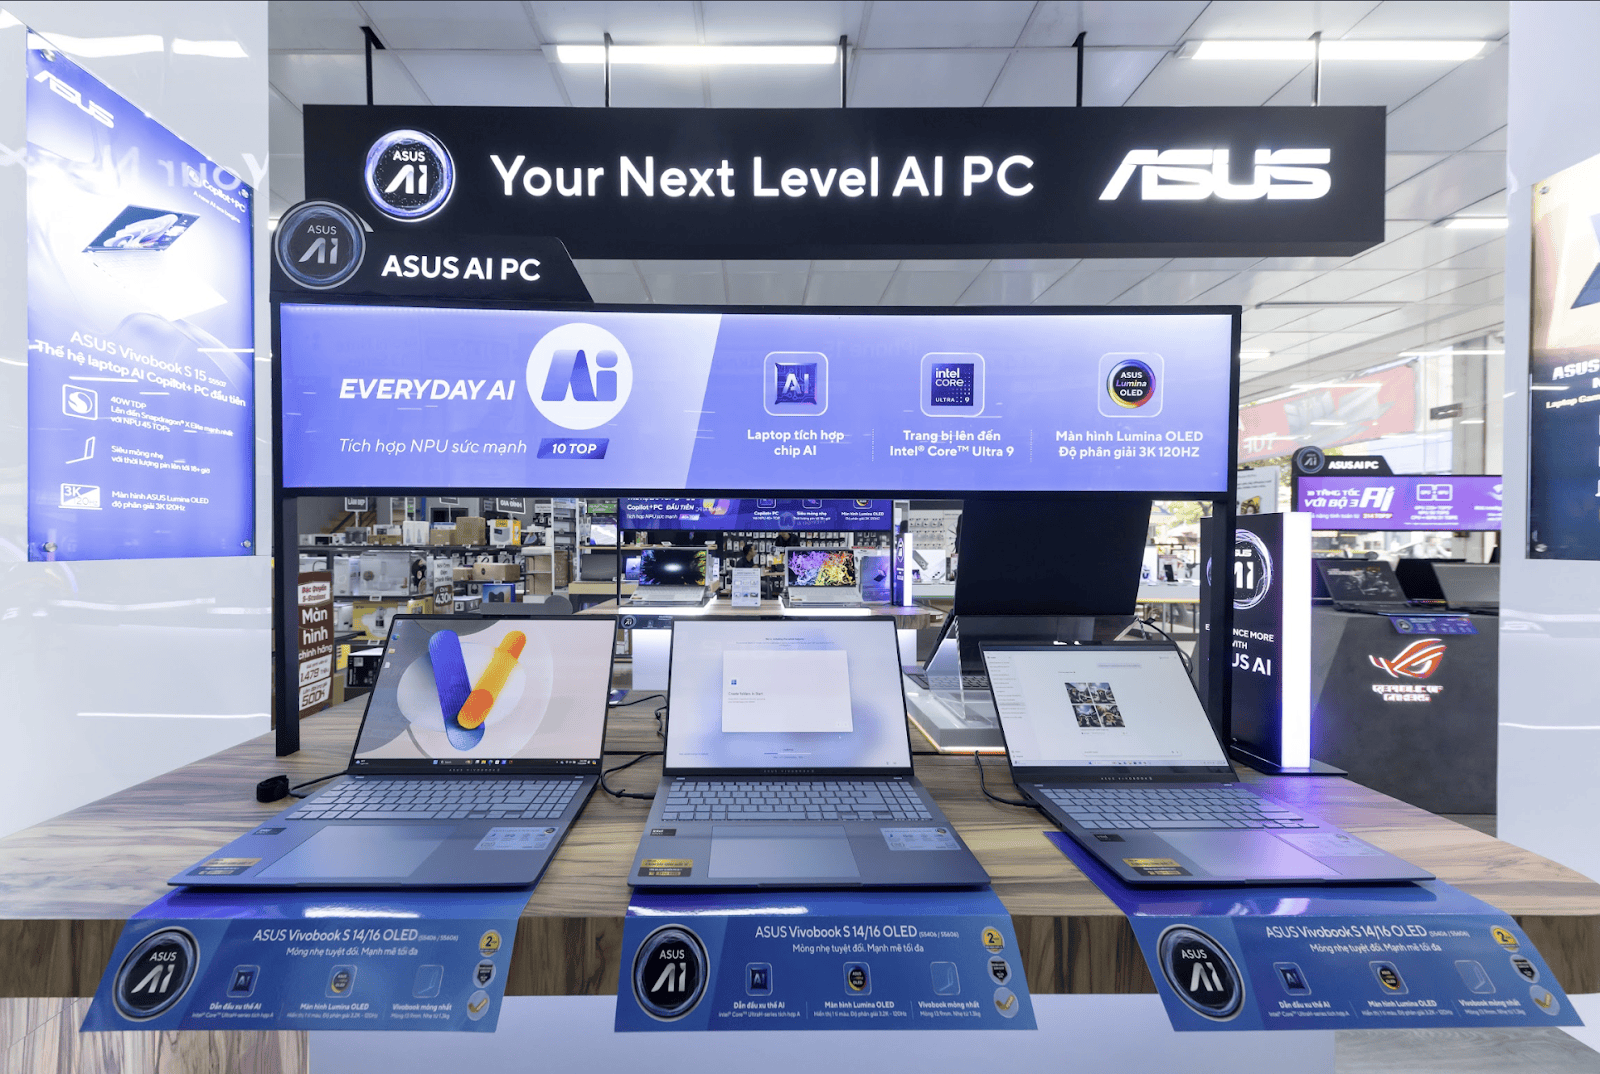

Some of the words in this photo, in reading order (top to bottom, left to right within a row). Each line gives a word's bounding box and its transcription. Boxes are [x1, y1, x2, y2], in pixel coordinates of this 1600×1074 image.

[34, 70, 114, 128] ASUS
[393, 151, 425, 162] ASUS
[490, 154, 604, 196] Your
[620, 155, 735, 197] Next
[753, 155, 879, 197] Level
[892, 155, 944, 197] AI
[964, 155, 1034, 197] PC
[1100, 148, 1332, 200] ASUS
[307, 225, 337, 236] ASUS
[381, 254, 460, 280] ASUS
[463, 256, 493, 280] AI
[500, 258, 540, 282] PC
[70, 331, 116, 355] ASUS
[119, 344, 182, 375] Vivobook
[184, 365, 192, 378] S
[194, 368, 207, 382] 15
[34, 339, 65, 358] Thế
[67, 348, 86, 366] hệ
[88, 354, 130, 378] laptop
[131, 366, 144, 380] AI
[146, 372, 192, 392] Copilot+
[194, 384, 209, 398] PC
[936, 368, 960, 378] intel
[1552, 358, 1600, 380] ASUS
[339, 378, 487, 400] EVERYDAY
[486, 380, 516, 401] AI
[782, 374, 809, 394] AI
[110, 396, 130, 406] 40W
[130, 400, 146, 410] TDP
[123, 417, 141, 428] NPU
[142, 420, 152, 429] 45
[746, 429, 791, 444] Laptop
[793, 429, 818, 442] tích
[820, 430, 845, 445] hợp
[903, 431, 938, 445] Trang
[940, 430, 953, 444] bị
[956, 430, 976, 442] lên
[978, 428, 1001, 442] đến
[1056, 430, 1084, 442] Màn
[1087, 430, 1113, 442] hình
[1116, 430, 1162, 442] Lumina
[1166, 430, 1204, 442] OLED
[339, 438, 371, 454] Tích
[374, 439, 406, 456] hợp
[410, 438, 450, 454] NPU
[451, 437, 480, 454] sức
[483, 440, 528, 457] mạnh
[552, 442, 568, 454] 10
[568, 443, 598, 454] TOP
[774, 444, 800, 458] chip
[803, 446, 817, 456] AI
[889, 445, 924, 458] Intel®
[927, 445, 970, 458] Core™
[972, 445, 1004, 458] Ultra
[1006, 446, 1014, 458] 9
[1058, 446, 1078, 460] Độ
[1080, 446, 1111, 460] phân
[1114, 446, 1137, 460] giải
[1139, 446, 1156, 458] 3K
[1158, 446, 1200, 458] 120HZ
[1328, 461, 1354, 470] ASUS
[1354, 461, 1364, 470] AI
[1365, 461, 1380, 470] PC
[64, 486, 81, 496] 3K
[146, 493, 166, 501] ASUS
[167, 494, 190, 503] Lumina
[190, 496, 210, 504] OLED
[1348, 499, 1360, 508] 3
[302, 608, 328, 624] Màn
[303, 626, 328, 645] hình
[1250, 631, 1274, 642] MORE
[1252, 657, 1271, 676] AI
[252, 928, 286, 941] ASUS
[289, 928, 341, 941] Vivobook
[342, 929, 351, 941] S
[352, 929, 380, 944] 14/16
[382, 929, 418, 941] OLED
[755, 926, 787, 938] ASUS
[788, 926, 841, 938] Vivobook
[843, 926, 850, 938] S
[852, 926, 880, 940] 14/16
[882, 925, 917, 938] OLED
[1266, 926, 1299, 938] ASUS
[1300, 926, 1351, 938] Vivobook
[1351, 926, 1360, 937] S
[1361, 926, 1391, 940] 14/16
[1393, 925, 1427, 937] OLED
[659, 950, 685, 959] ASUS
[867, 944, 888, 954] Mạnh
[1182, 949, 1207, 959] ASUS
[150, 951, 176, 962] ASUS
